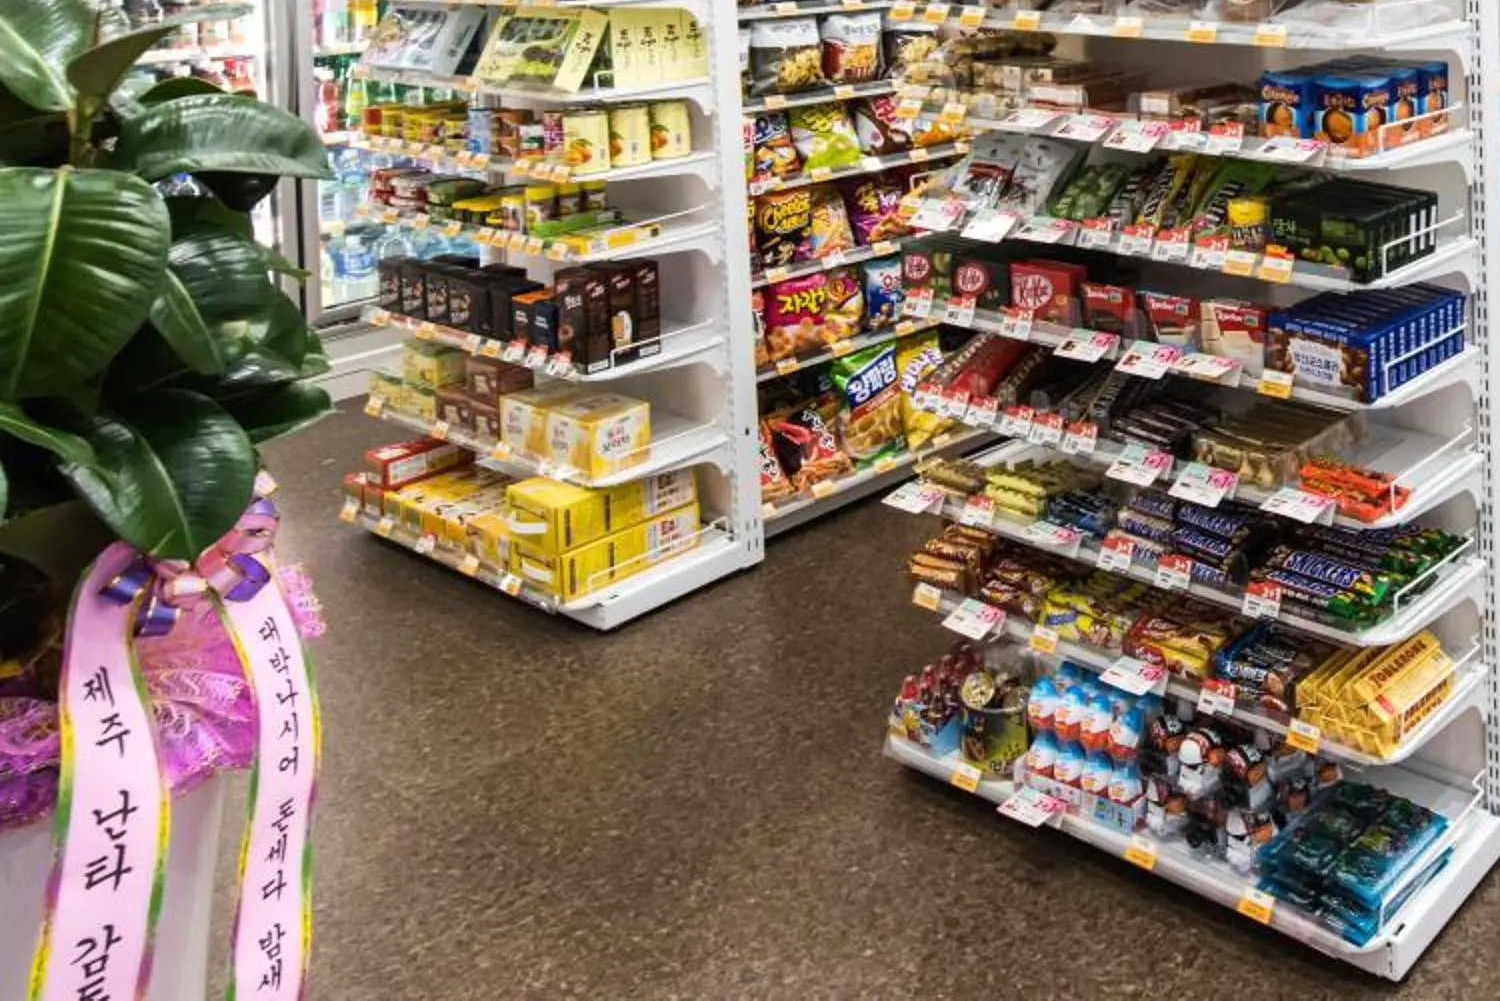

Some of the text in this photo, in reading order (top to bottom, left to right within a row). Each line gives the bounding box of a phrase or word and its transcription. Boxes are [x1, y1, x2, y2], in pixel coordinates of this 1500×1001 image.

[1283, 549, 1363, 591] SNICKERS
[1371, 639, 1428, 686] TOBLERONE
[81, 665, 131, 757] 제주
[85, 789, 138, 892] 난타
[257, 615, 299, 993] 대박나시어 돈세다 밤새
